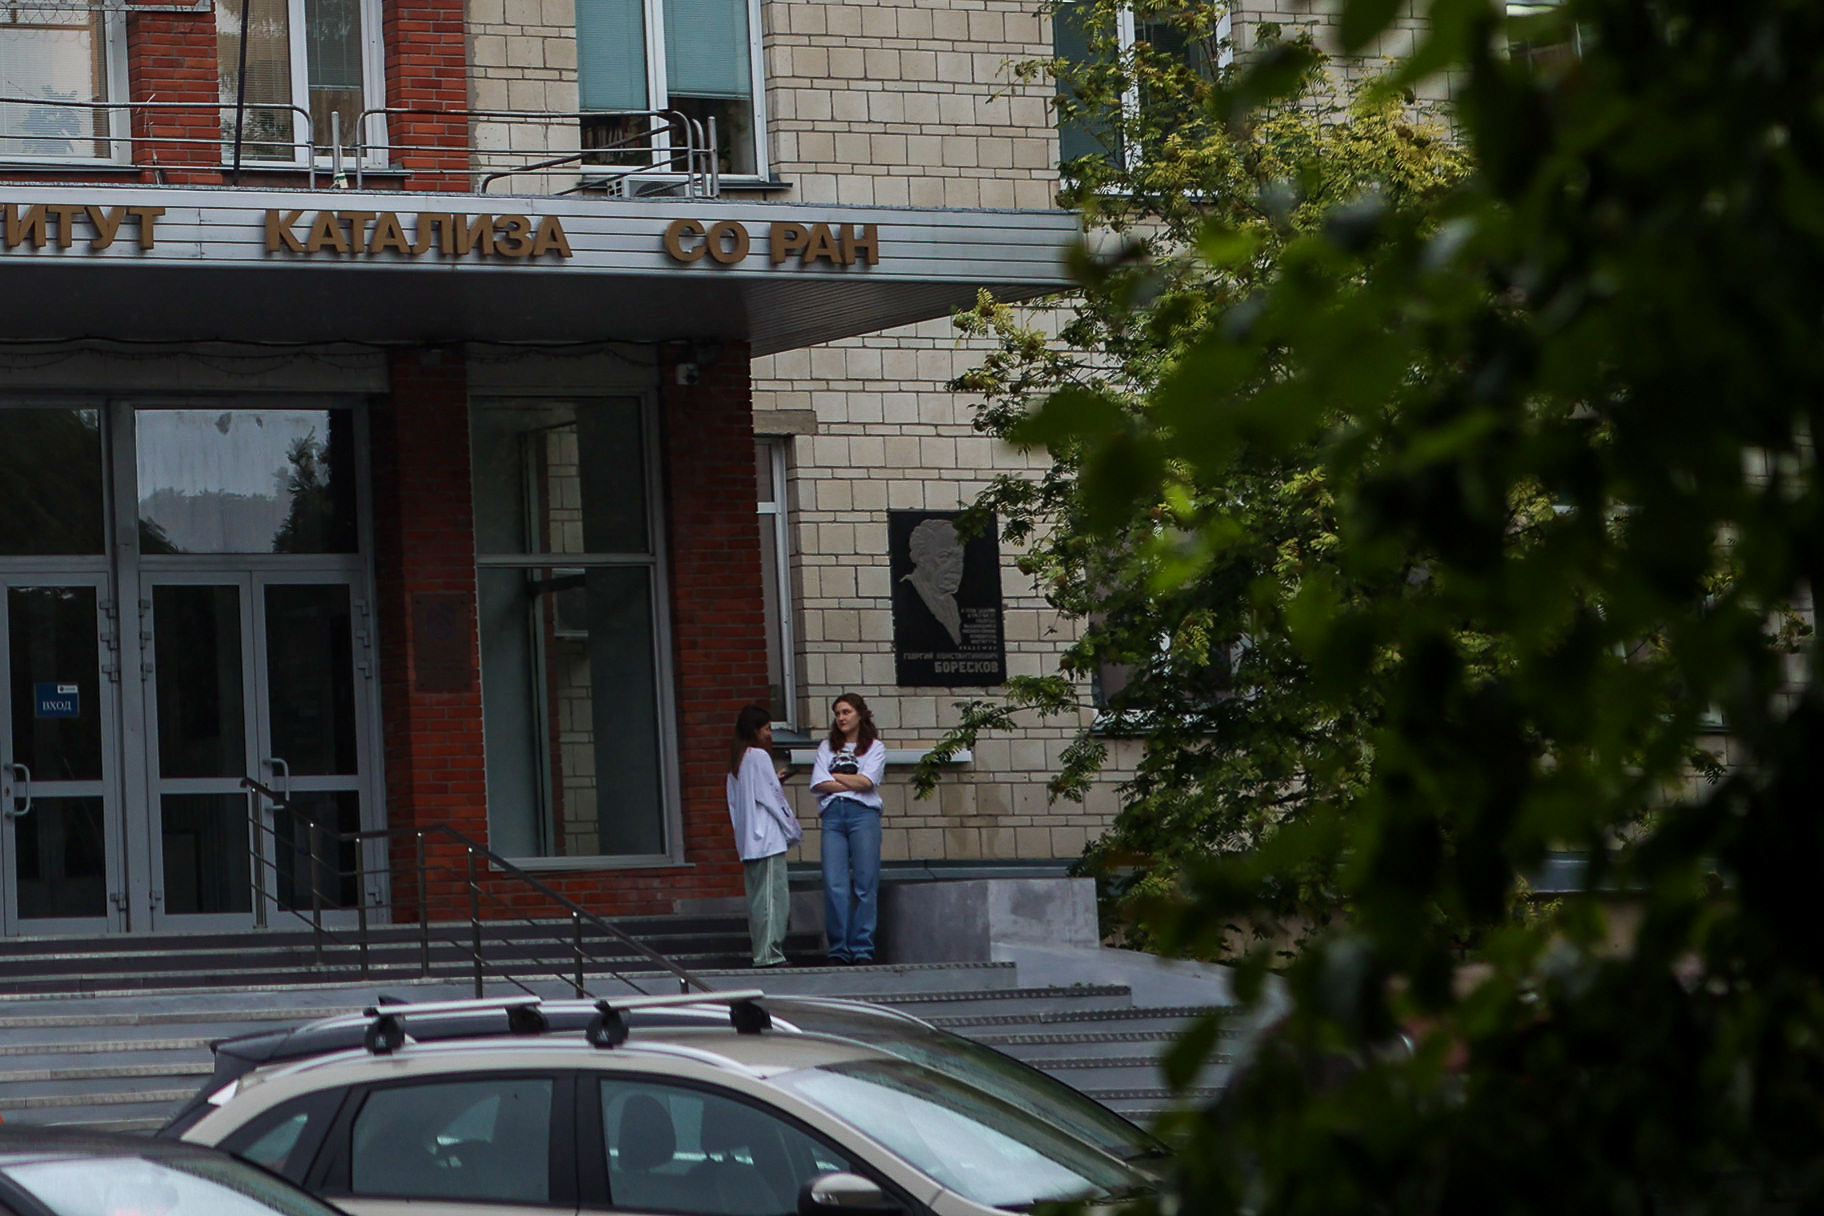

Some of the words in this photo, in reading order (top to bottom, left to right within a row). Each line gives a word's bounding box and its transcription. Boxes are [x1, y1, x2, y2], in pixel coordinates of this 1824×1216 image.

[264, 208, 573, 258] КАТАЛИЗА
[664, 219, 750, 264] СО
[770, 222, 879, 266] РАН
[934, 661, 999, 673] БОРЕСКОВ
[42, 700, 72, 711] ВХОД
